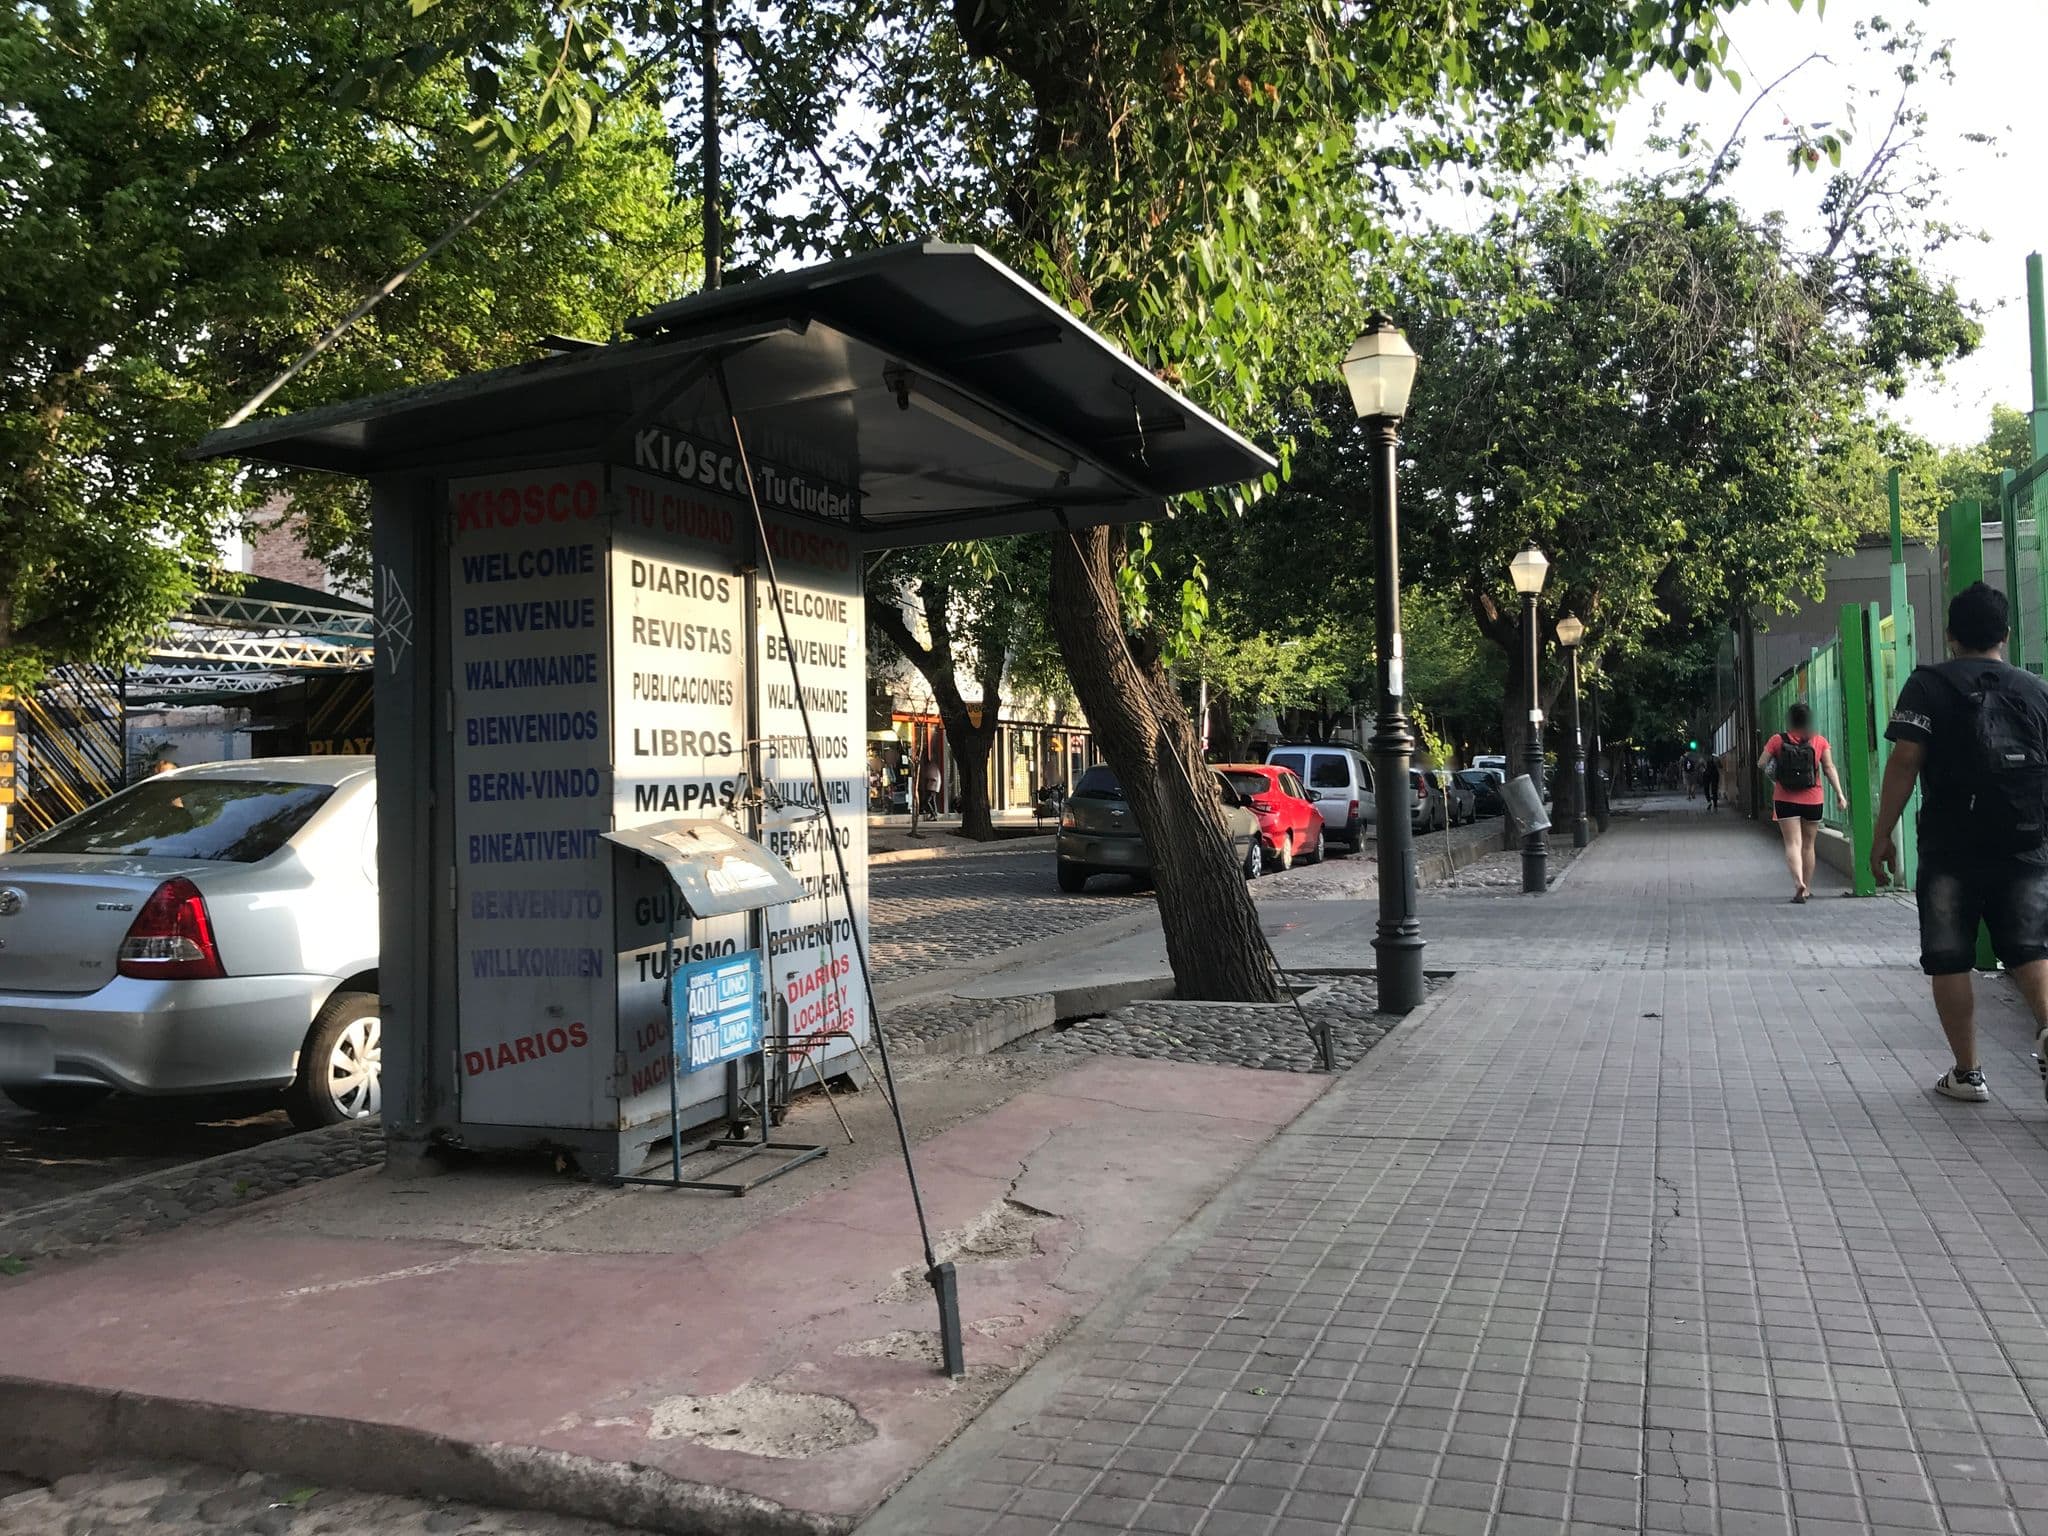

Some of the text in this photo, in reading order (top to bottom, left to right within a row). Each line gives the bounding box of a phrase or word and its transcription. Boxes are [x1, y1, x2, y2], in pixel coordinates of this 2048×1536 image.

[457, 480, 597, 532] KIOSCO
[626, 484, 733, 544] TU CIUDAD
[762, 466, 785, 505] Tu
[789, 477, 850, 524] Ciudad
[462, 543, 594, 585] WELCOME
[632, 559, 730, 603] DIARIOS
[464, 598, 595, 637] BENVENUE
[633, 616, 732, 655] REVISTAS
[464, 653, 598, 691] WALKMNANDE
[633, 672, 733, 706] PUBLICACIONES
[466, 710, 598, 746] BIENVENIDOS
[634, 728, 732, 758] LIBROS
[468, 768, 600, 802] BERN-VINDO
[635, 780, 735, 813] MAPAS
[469, 829, 600, 864] BINEATIVENIT
[471, 888, 602, 921] BENVENUTO
[471, 948, 603, 979] WILLKOMMEN
[788, 954, 850, 1004] DIARIOS
[722, 975, 746, 997] UNO
[794, 992, 839, 1034] LOCALES
[464, 1022, 588, 1076] DIARIOS
[724, 1021, 748, 1044] UNO
